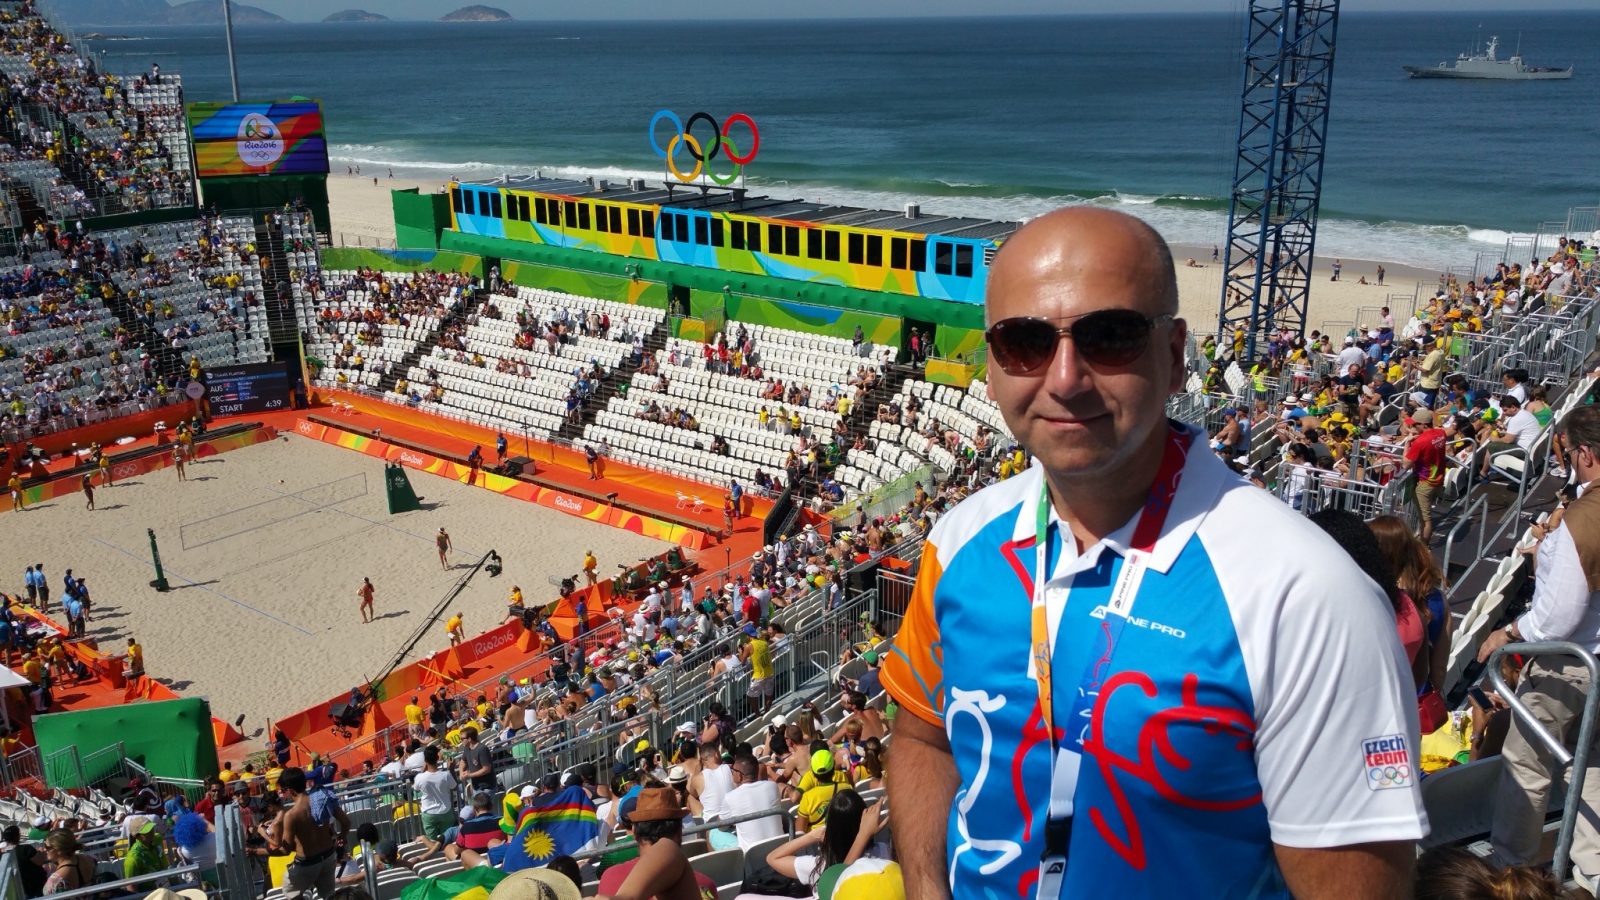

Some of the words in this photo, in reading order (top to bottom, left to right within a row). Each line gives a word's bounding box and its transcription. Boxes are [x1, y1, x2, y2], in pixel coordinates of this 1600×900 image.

[210, 385, 224, 393] AUS
[219, 404, 244, 413] START
[265, 399, 282, 408] 4:39
[1150, 621, 1187, 639] PRO
[474, 629, 514, 655] Rio2016
[1364, 735, 1406, 754] czech
[1366, 750, 1408, 768] team
